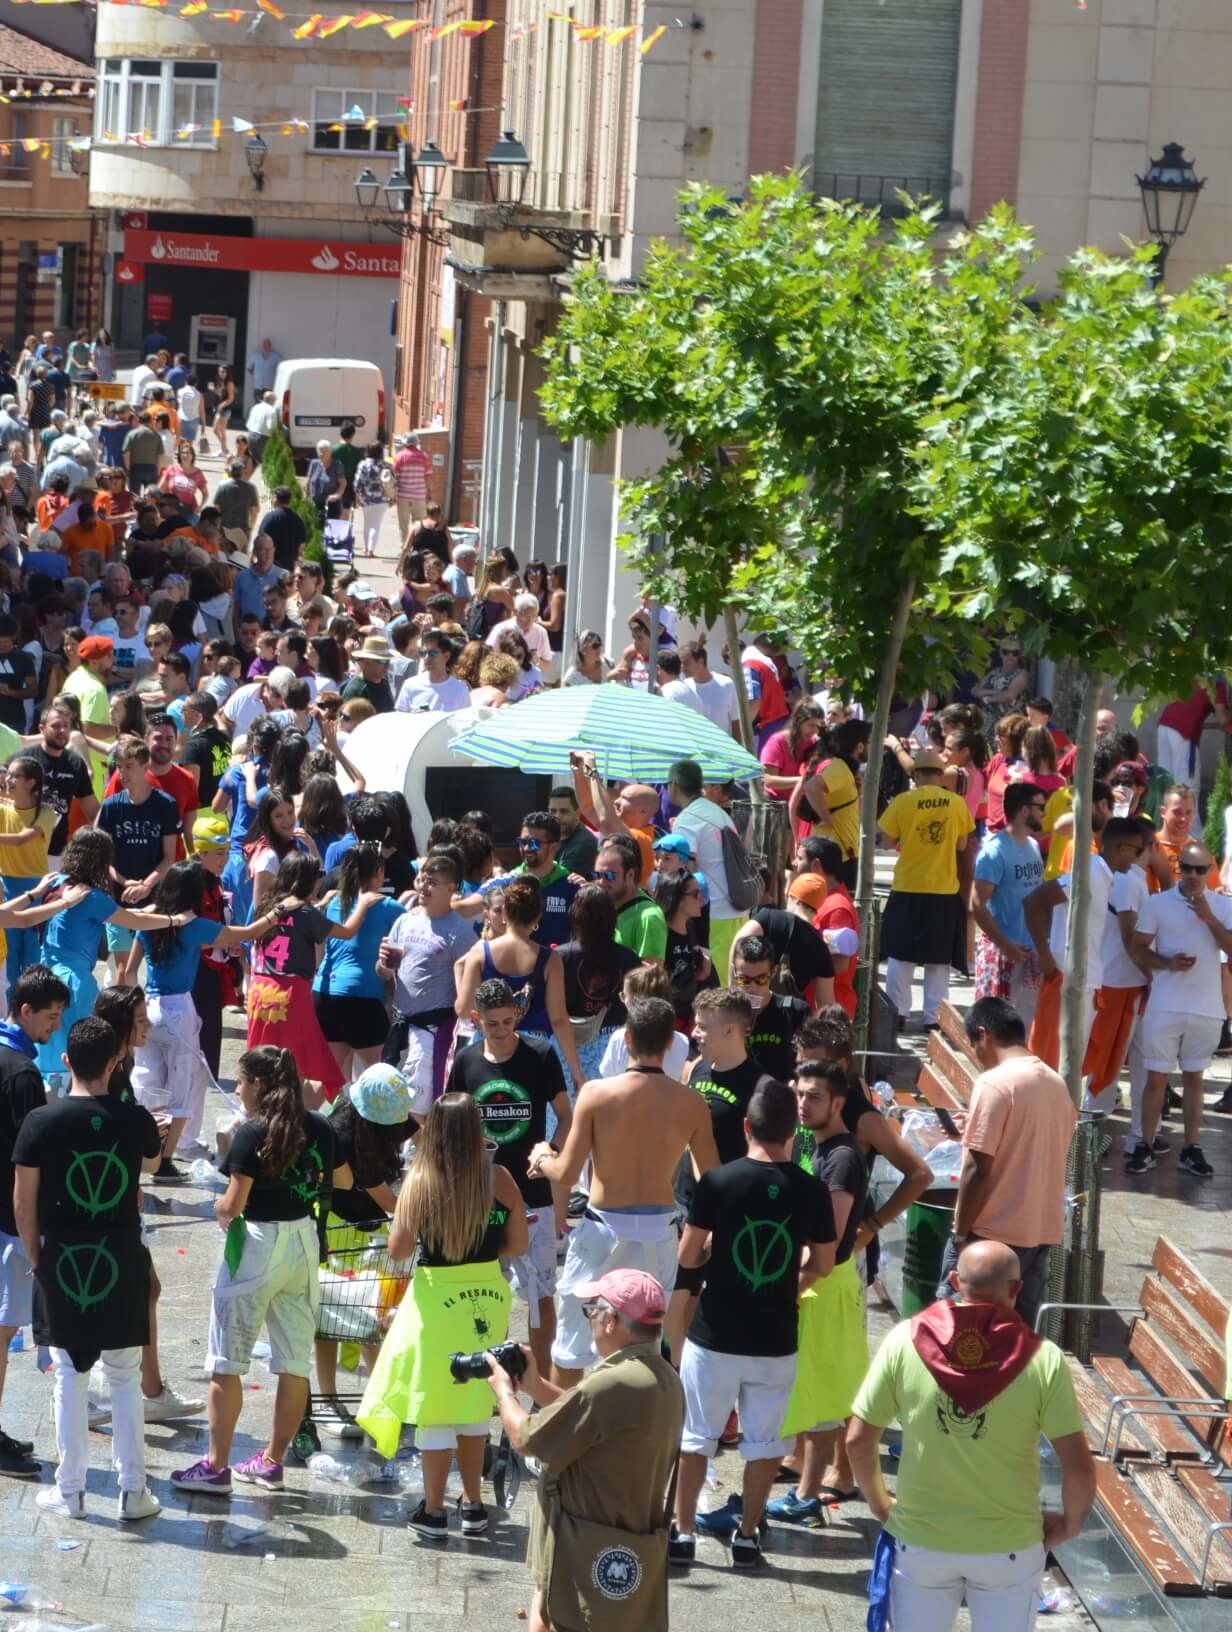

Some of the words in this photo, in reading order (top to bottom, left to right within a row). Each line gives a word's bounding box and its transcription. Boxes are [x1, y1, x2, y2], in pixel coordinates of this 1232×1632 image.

[167, 240, 220, 262] Santander
[918, 798, 951, 810] KOLIN
[486, 1106, 529, 1117] Resakon
